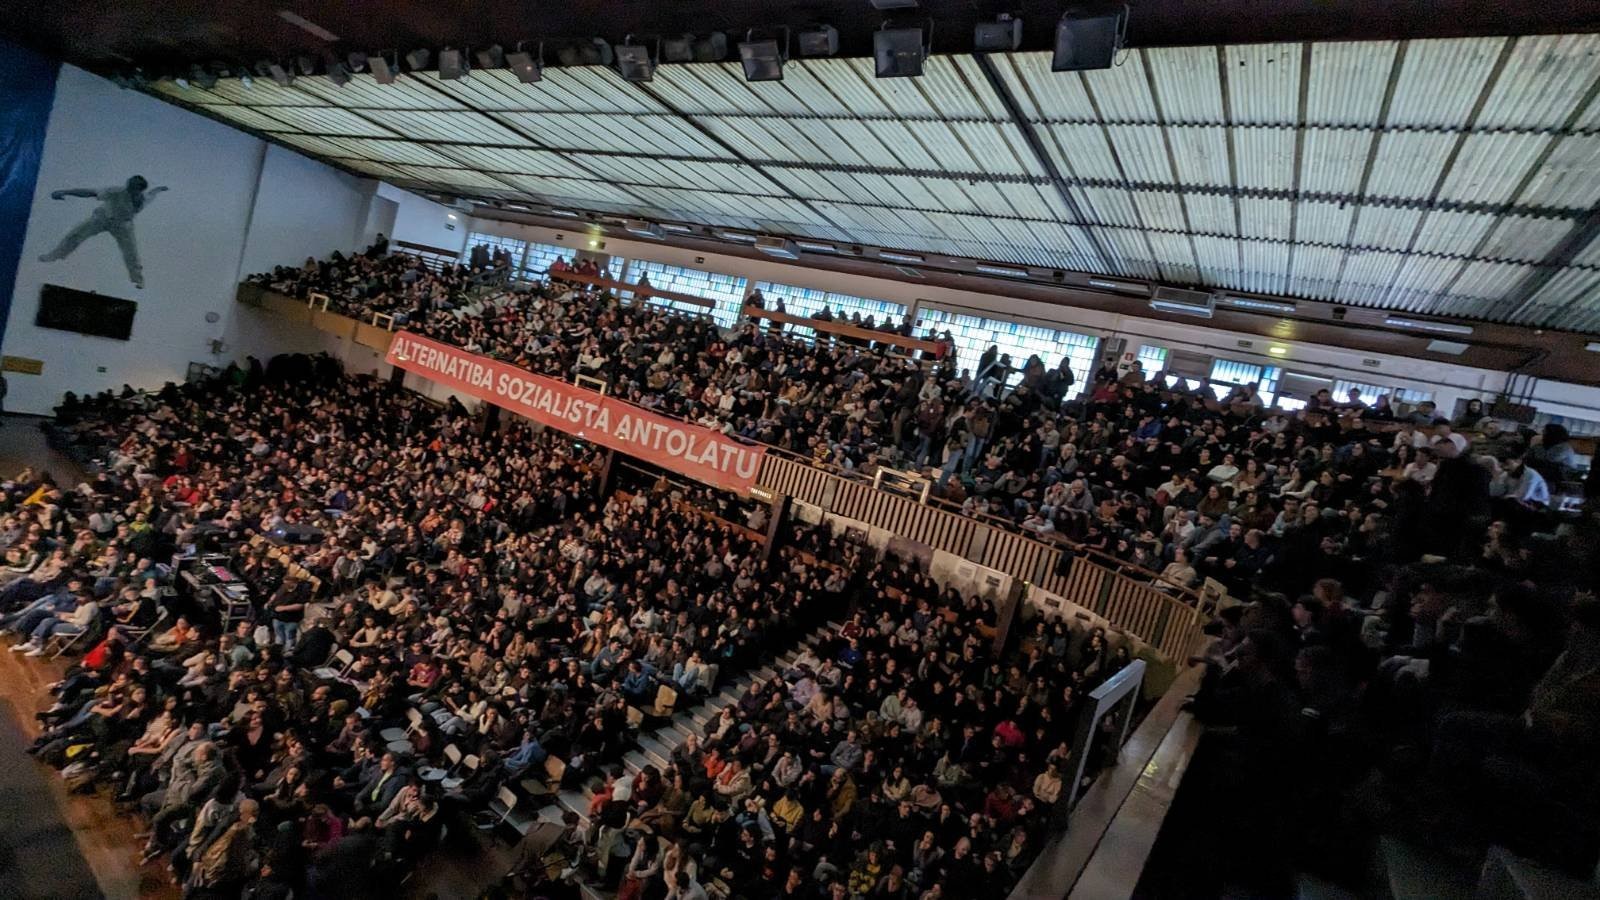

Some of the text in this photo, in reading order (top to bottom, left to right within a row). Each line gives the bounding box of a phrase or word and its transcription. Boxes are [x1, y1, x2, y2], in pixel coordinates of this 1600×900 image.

[391, 337, 758, 479] ALTERNATIBA SOZIALISTA ANTOLATU
